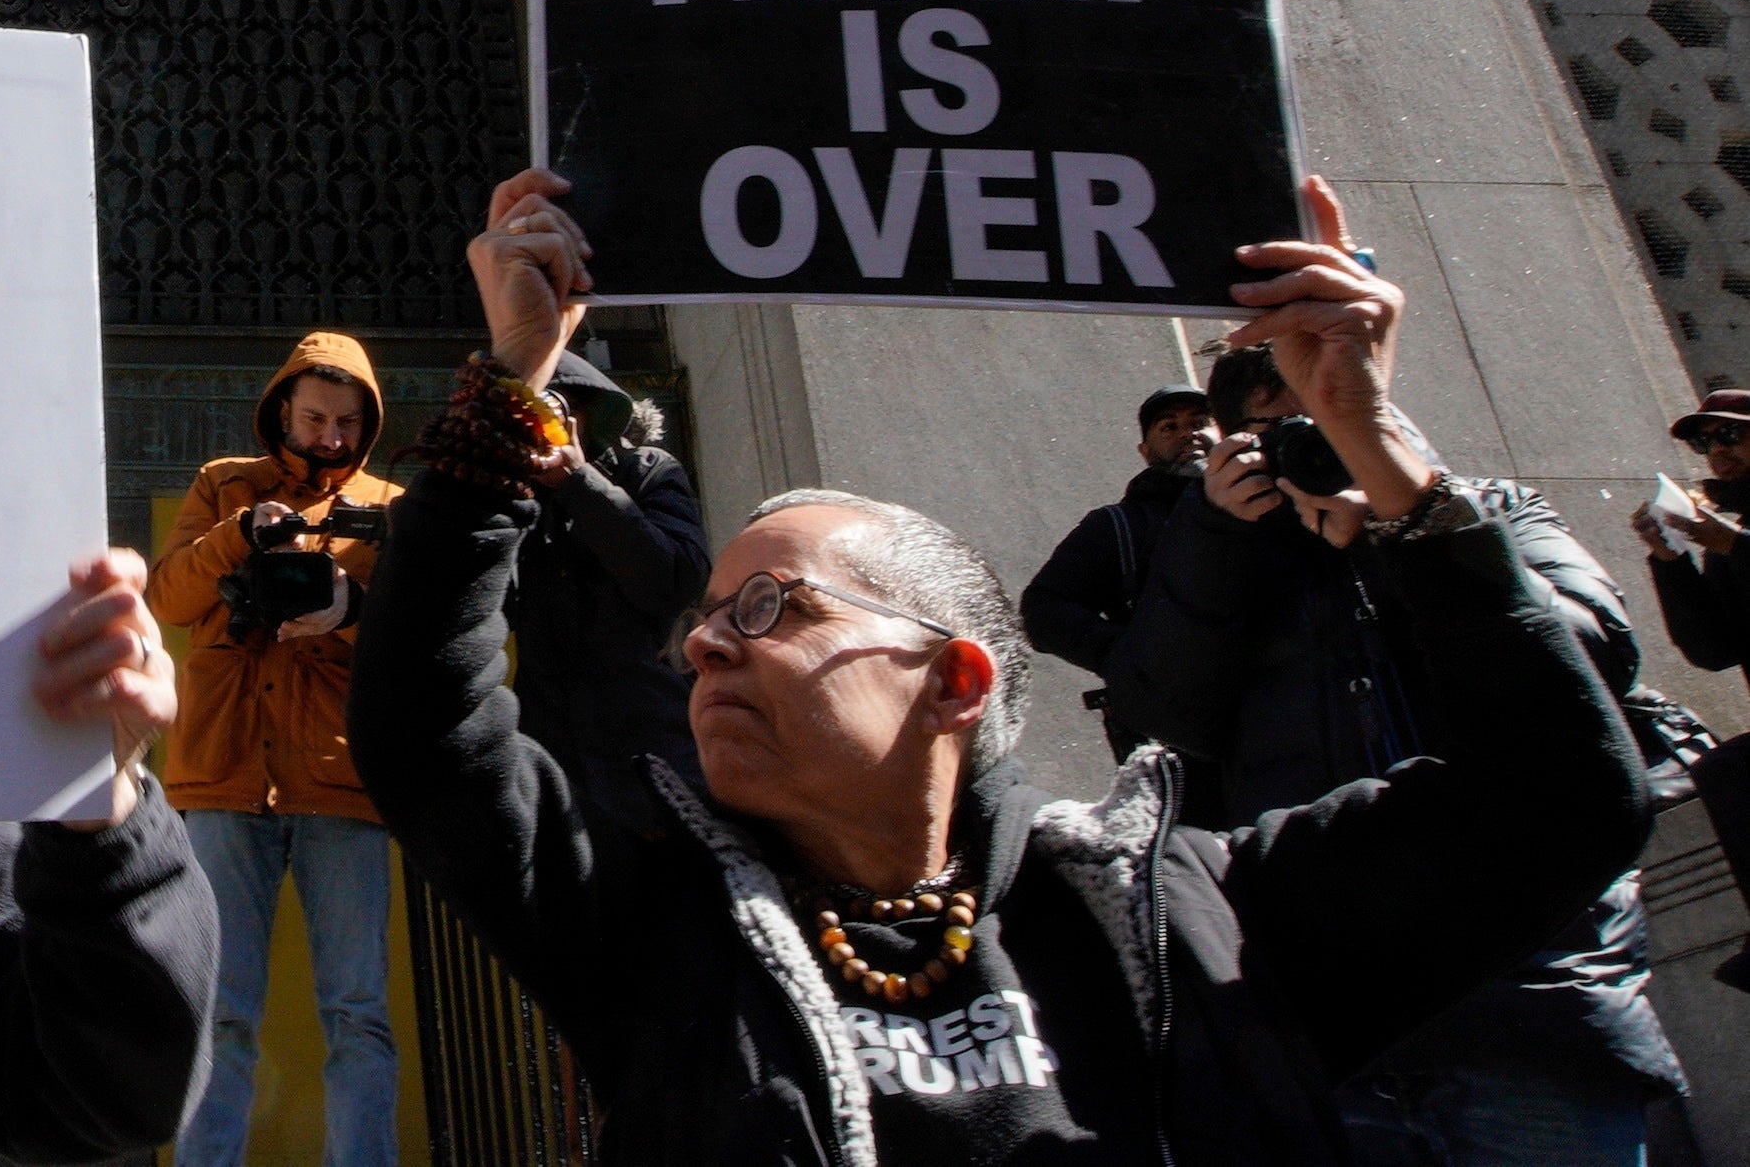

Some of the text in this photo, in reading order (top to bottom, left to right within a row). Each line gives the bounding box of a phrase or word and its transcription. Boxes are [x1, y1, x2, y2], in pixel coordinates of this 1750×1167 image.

[839, 7, 1000, 136] IS
[699, 145, 1176, 290] OVER
[840, 989, 1038, 1057] RREST
[853, 1035, 1059, 1096] RUMP
